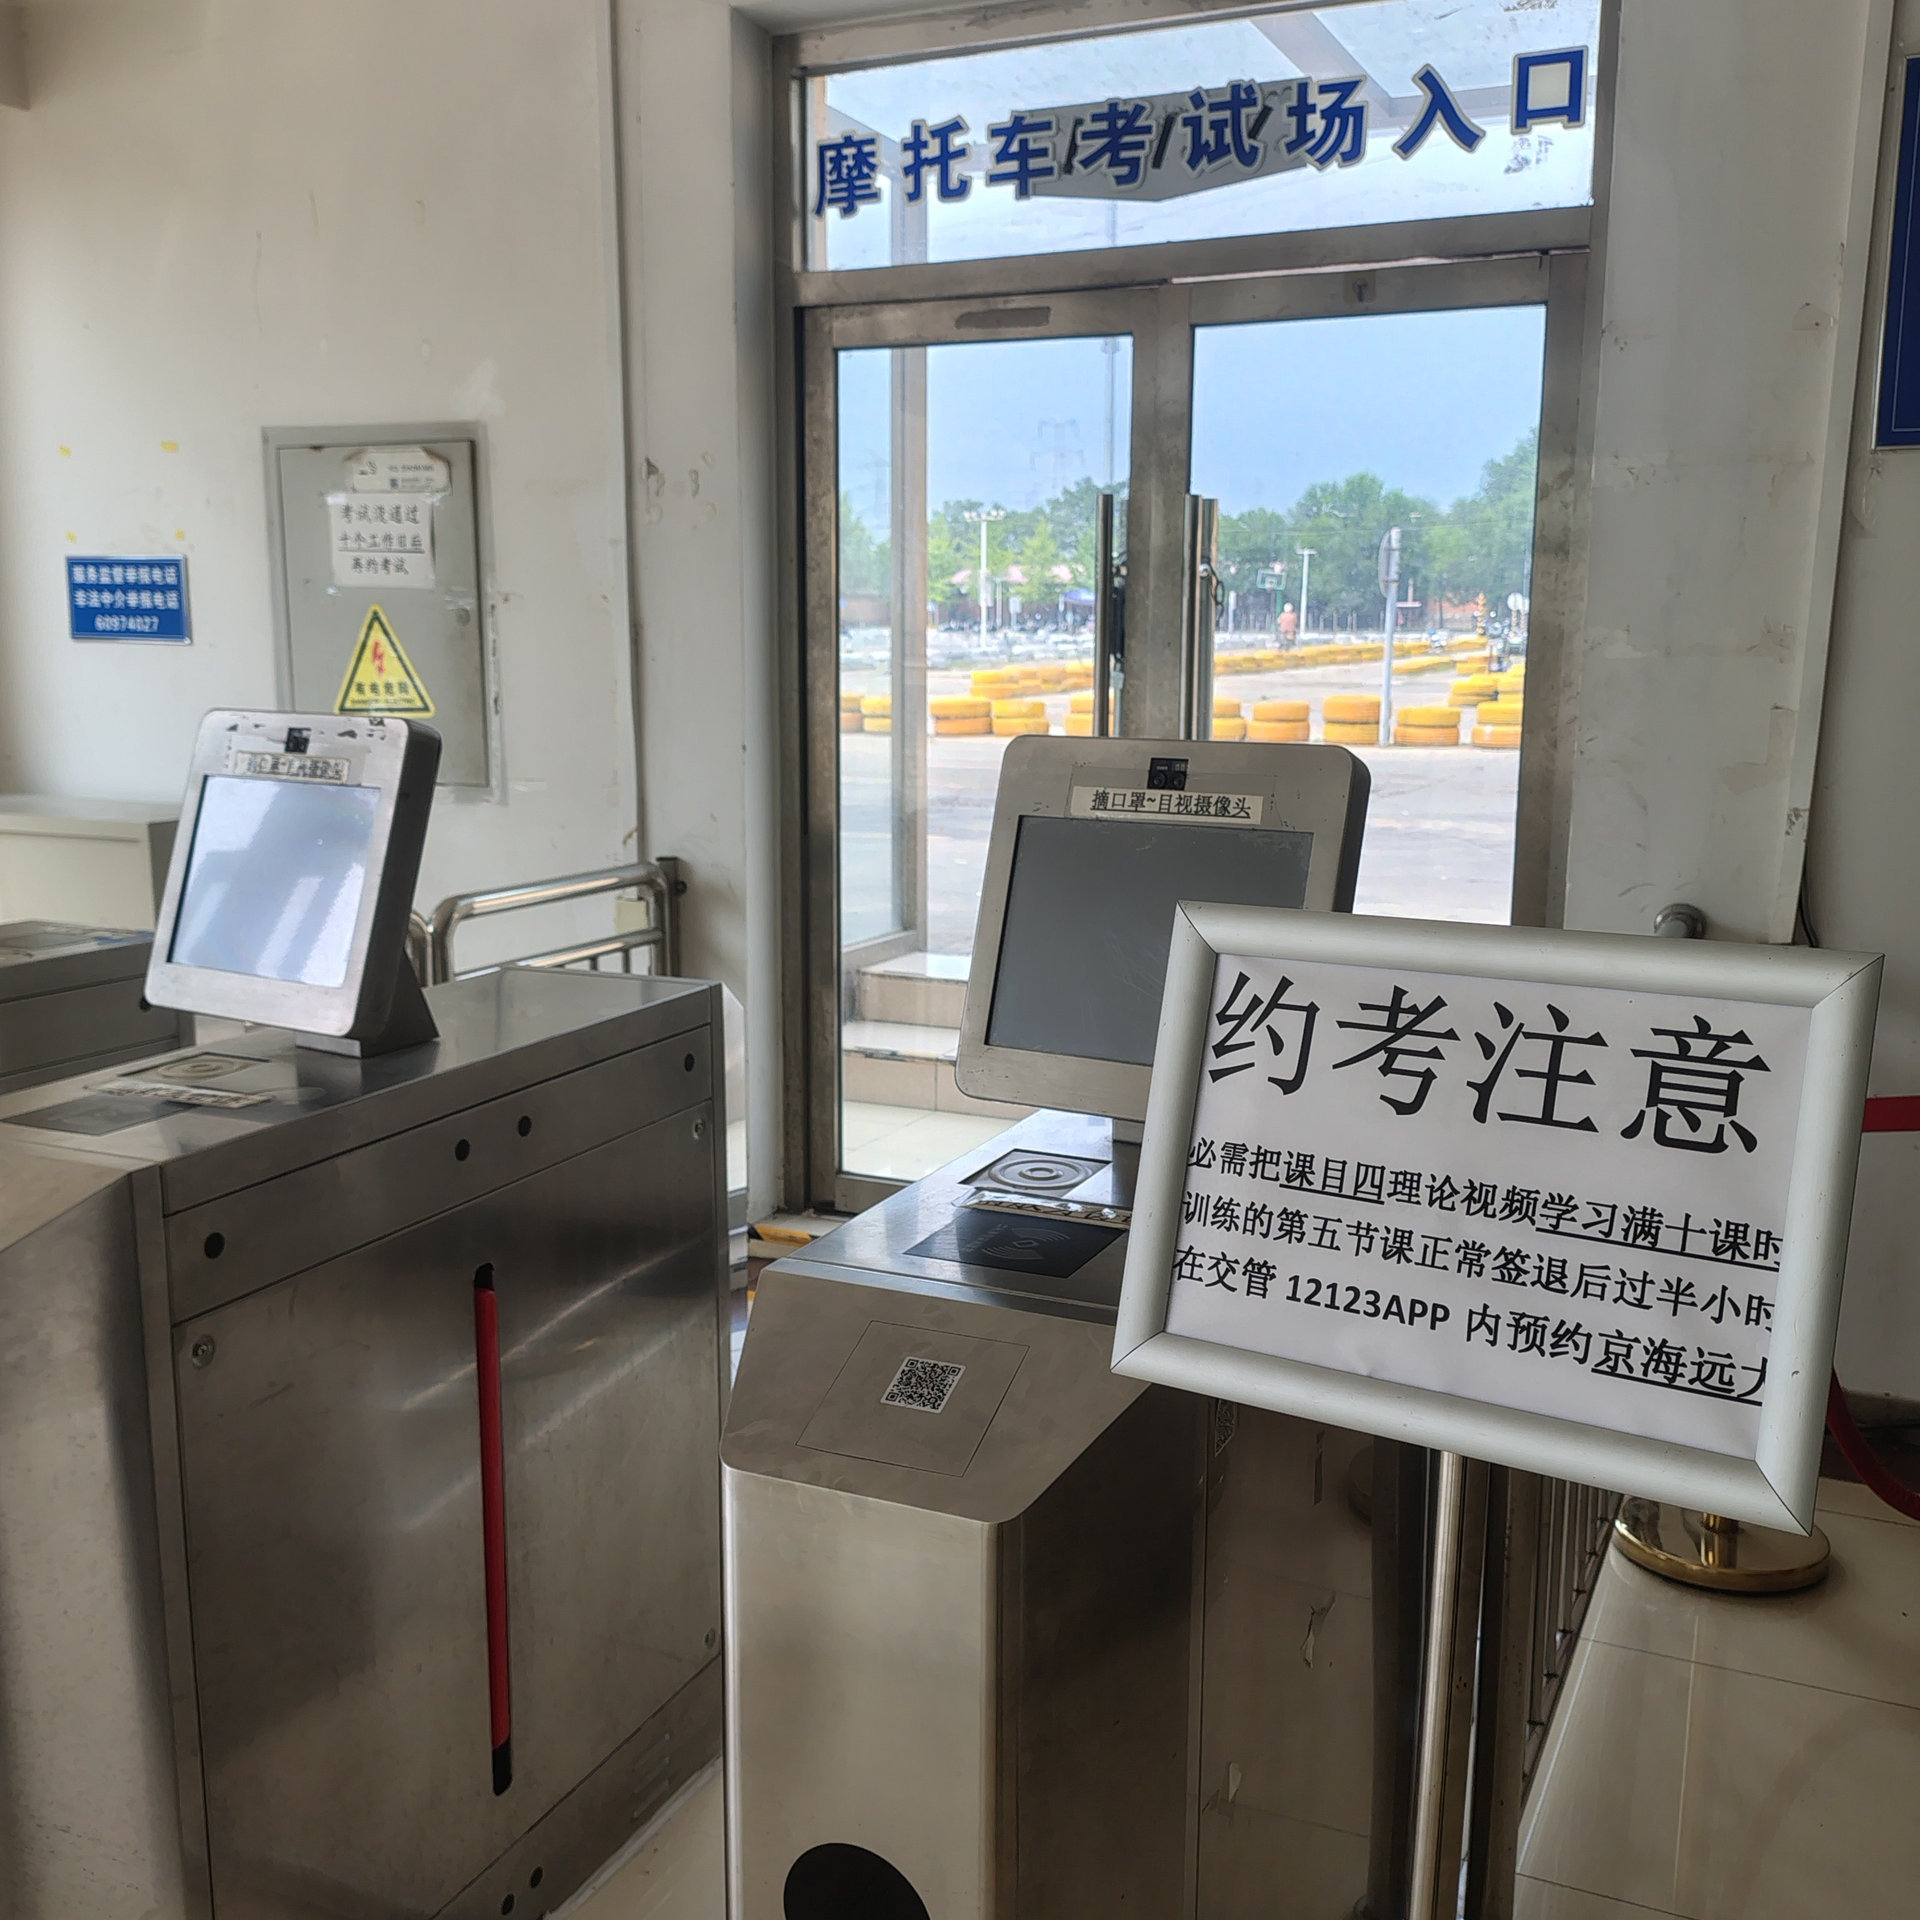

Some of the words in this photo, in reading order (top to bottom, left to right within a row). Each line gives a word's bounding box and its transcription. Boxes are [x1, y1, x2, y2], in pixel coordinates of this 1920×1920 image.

[815, 46, 1588, 216] 摩托车考试场入口
[1209, 971, 1771, 1153] 约考注意
[1172, 1245, 1277, 1299] 在交管
[1285, 1275, 1450, 1331] 12123APP
